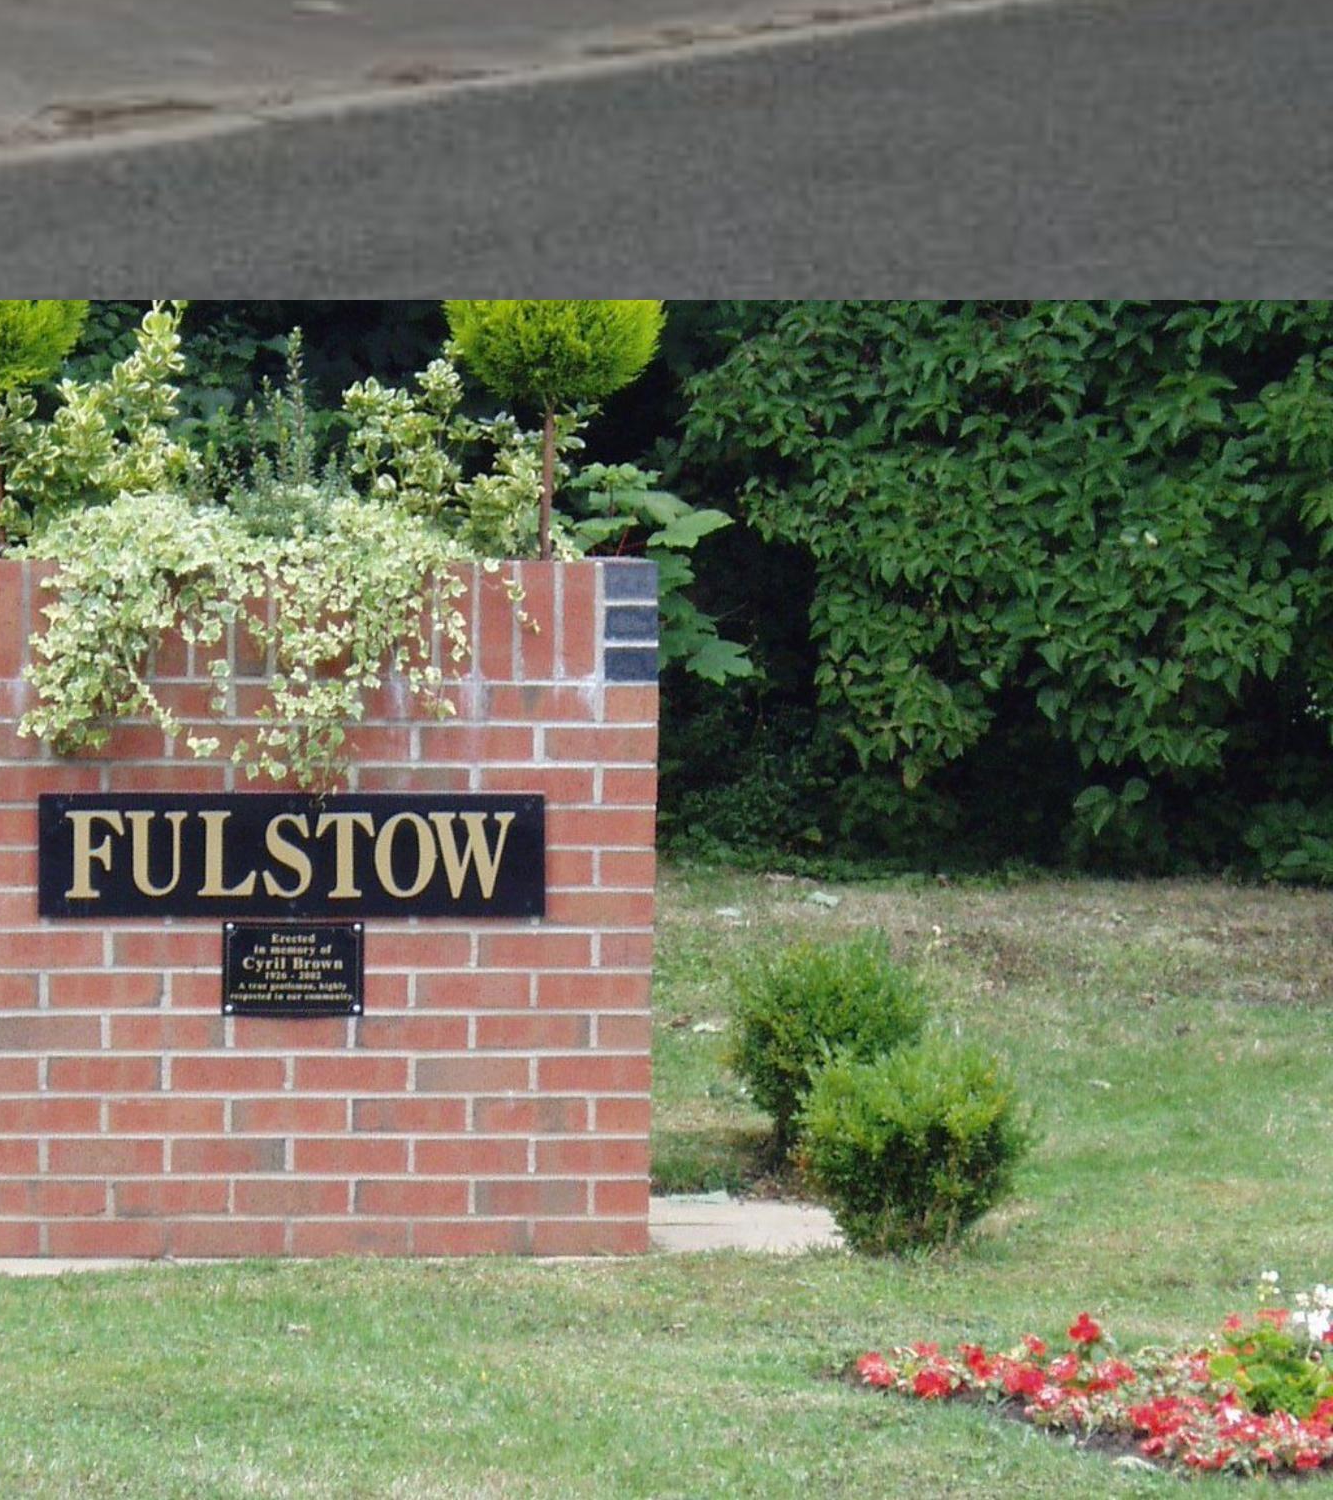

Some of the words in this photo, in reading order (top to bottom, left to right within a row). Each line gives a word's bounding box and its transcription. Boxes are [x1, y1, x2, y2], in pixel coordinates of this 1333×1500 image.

[62, 810, 516, 899] FULSTOW
[271, 933, 316, 943] Erected
[270, 946, 316, 956] memory
[320, 944, 332, 954] of
[242, 957, 286, 973] Cyril
[293, 957, 344, 970] Brown
[238, 982, 246, 990] A
[318, 982, 347, 992] highly
[230, 993, 272, 1002] respected
[274, 992, 284, 1000] in
